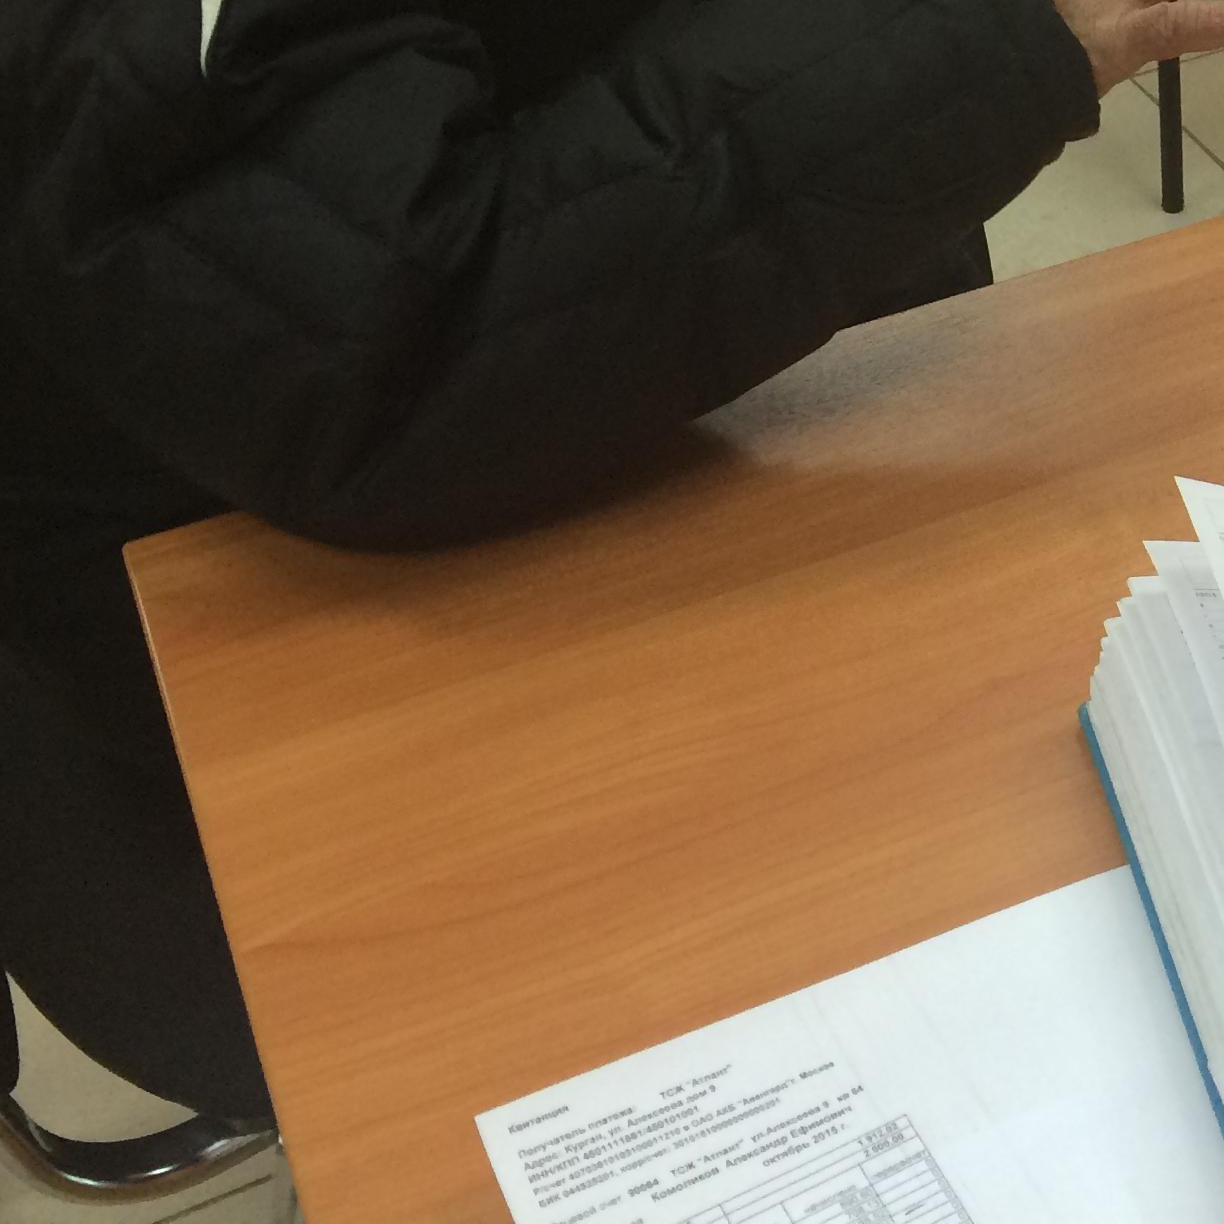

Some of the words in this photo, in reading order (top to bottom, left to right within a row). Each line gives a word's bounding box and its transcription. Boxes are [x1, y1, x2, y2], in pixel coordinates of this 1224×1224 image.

[726, 1136, 788, 1167] Александр
[790, 1106, 851, 1138] Ефимович
[763, 1143, 810, 1166] октябрь
